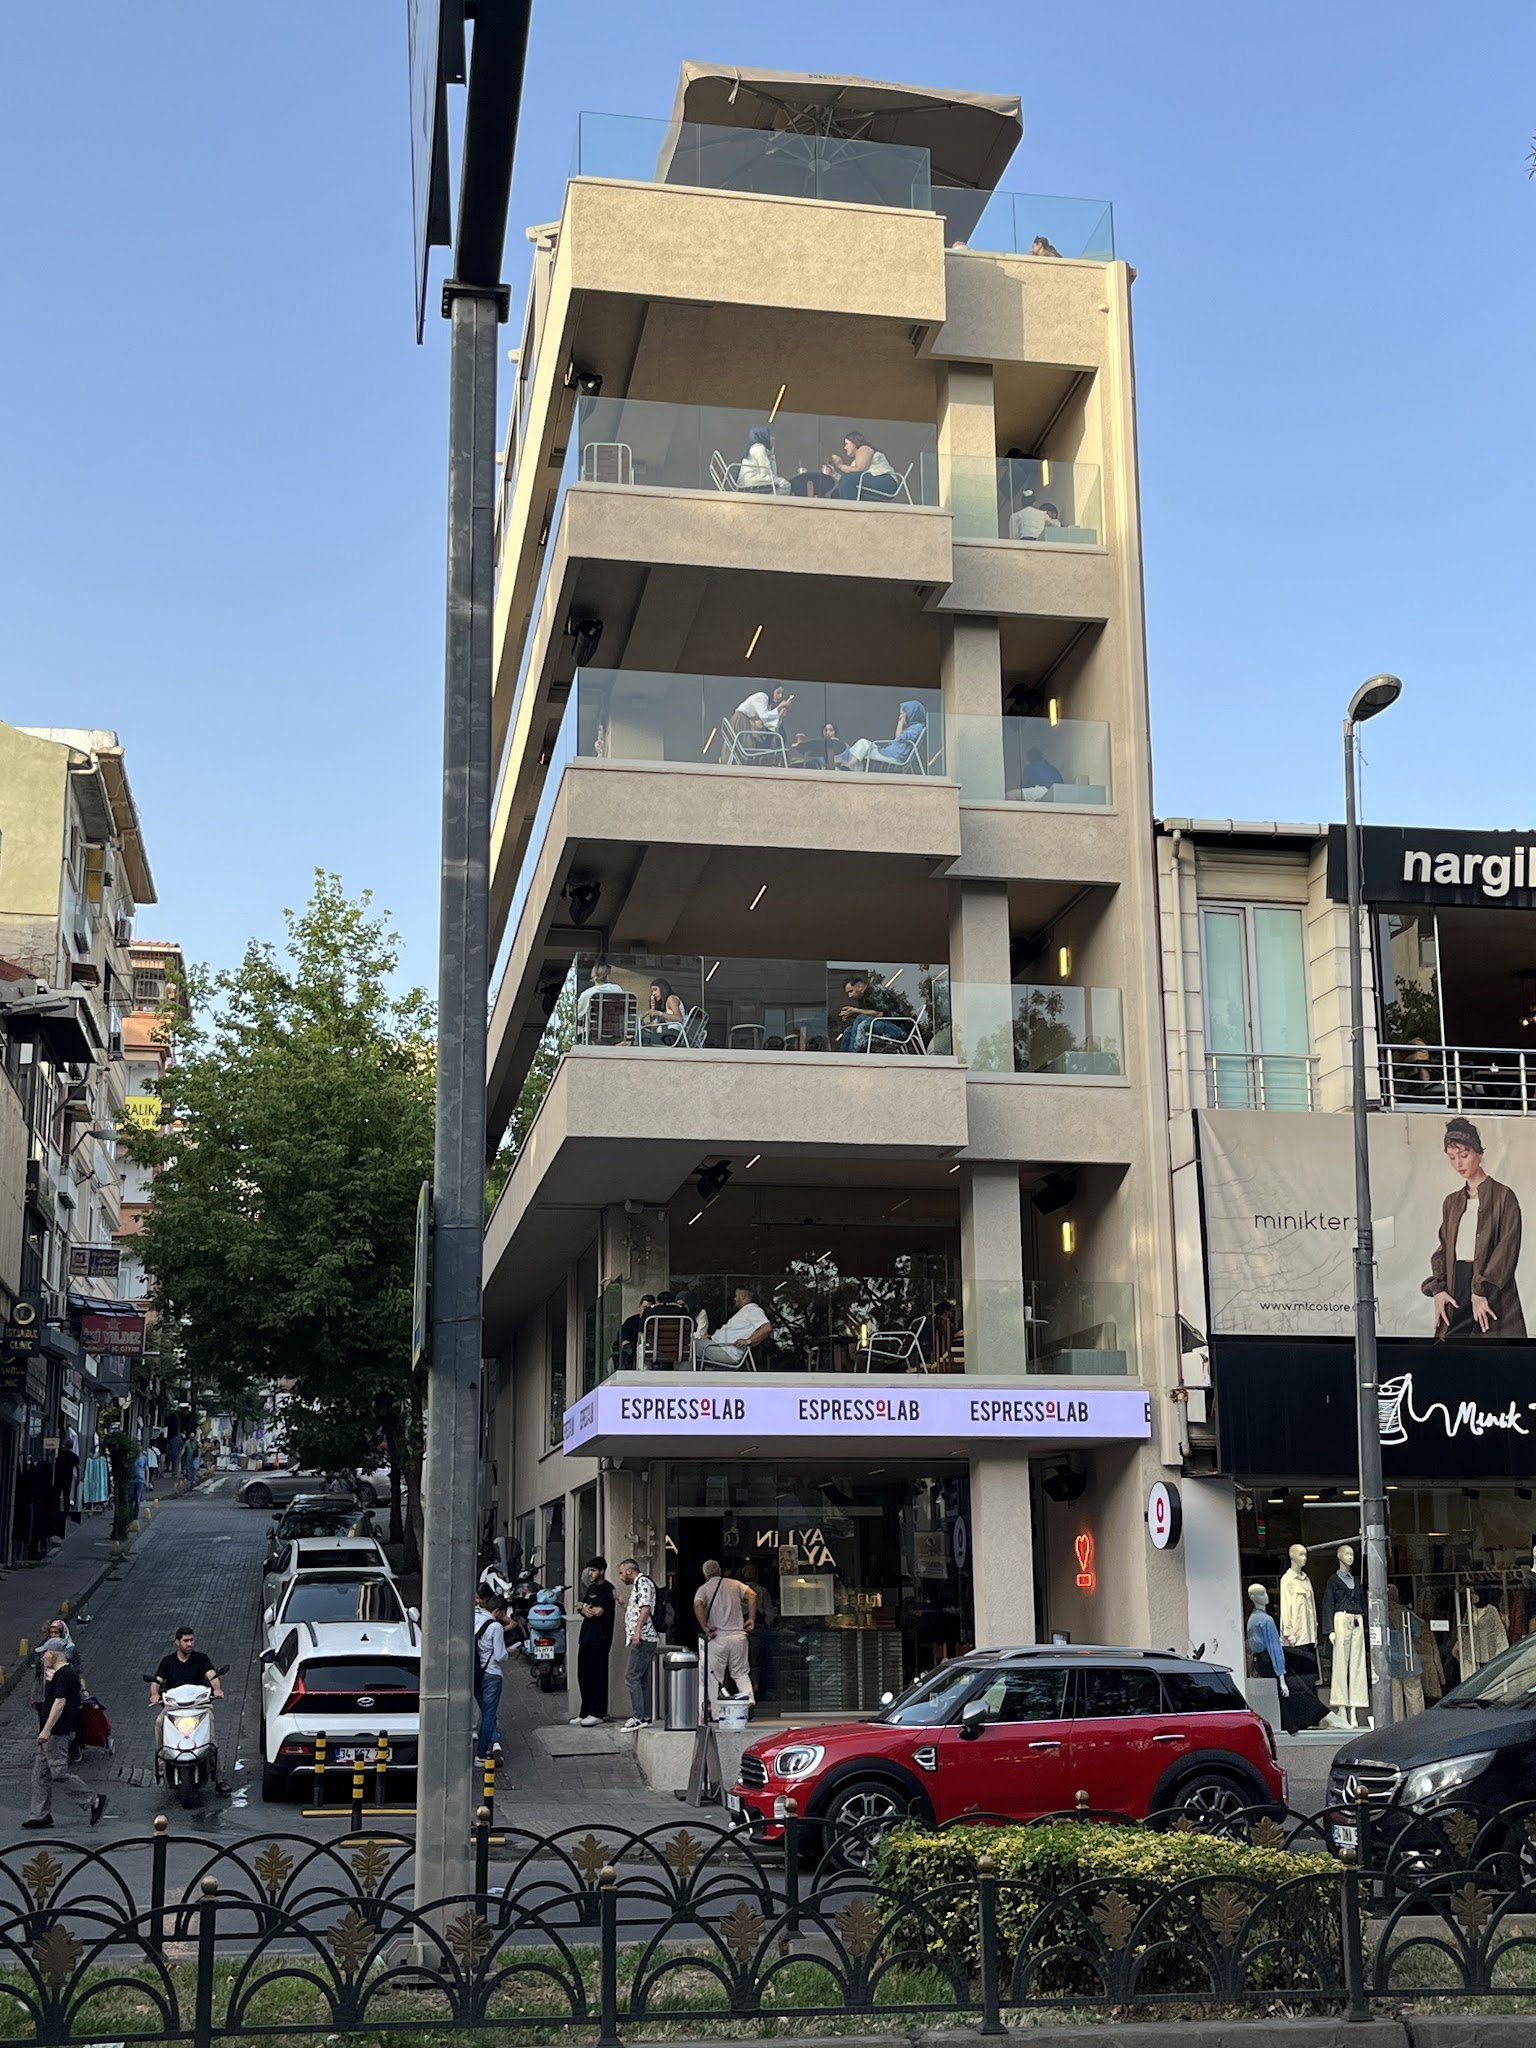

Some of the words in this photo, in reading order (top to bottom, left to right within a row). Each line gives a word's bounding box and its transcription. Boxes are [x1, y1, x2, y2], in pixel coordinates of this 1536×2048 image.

[1403, 846, 1536, 897] nargil
[621, 1398, 745, 1420] ESPRESSOLAB
[799, 1399, 919, 1421] ESPRESSOLAB
[971, 1400, 1088, 1422] ESPRESSOLAB
[340, 1749, 351, 1759] 34
